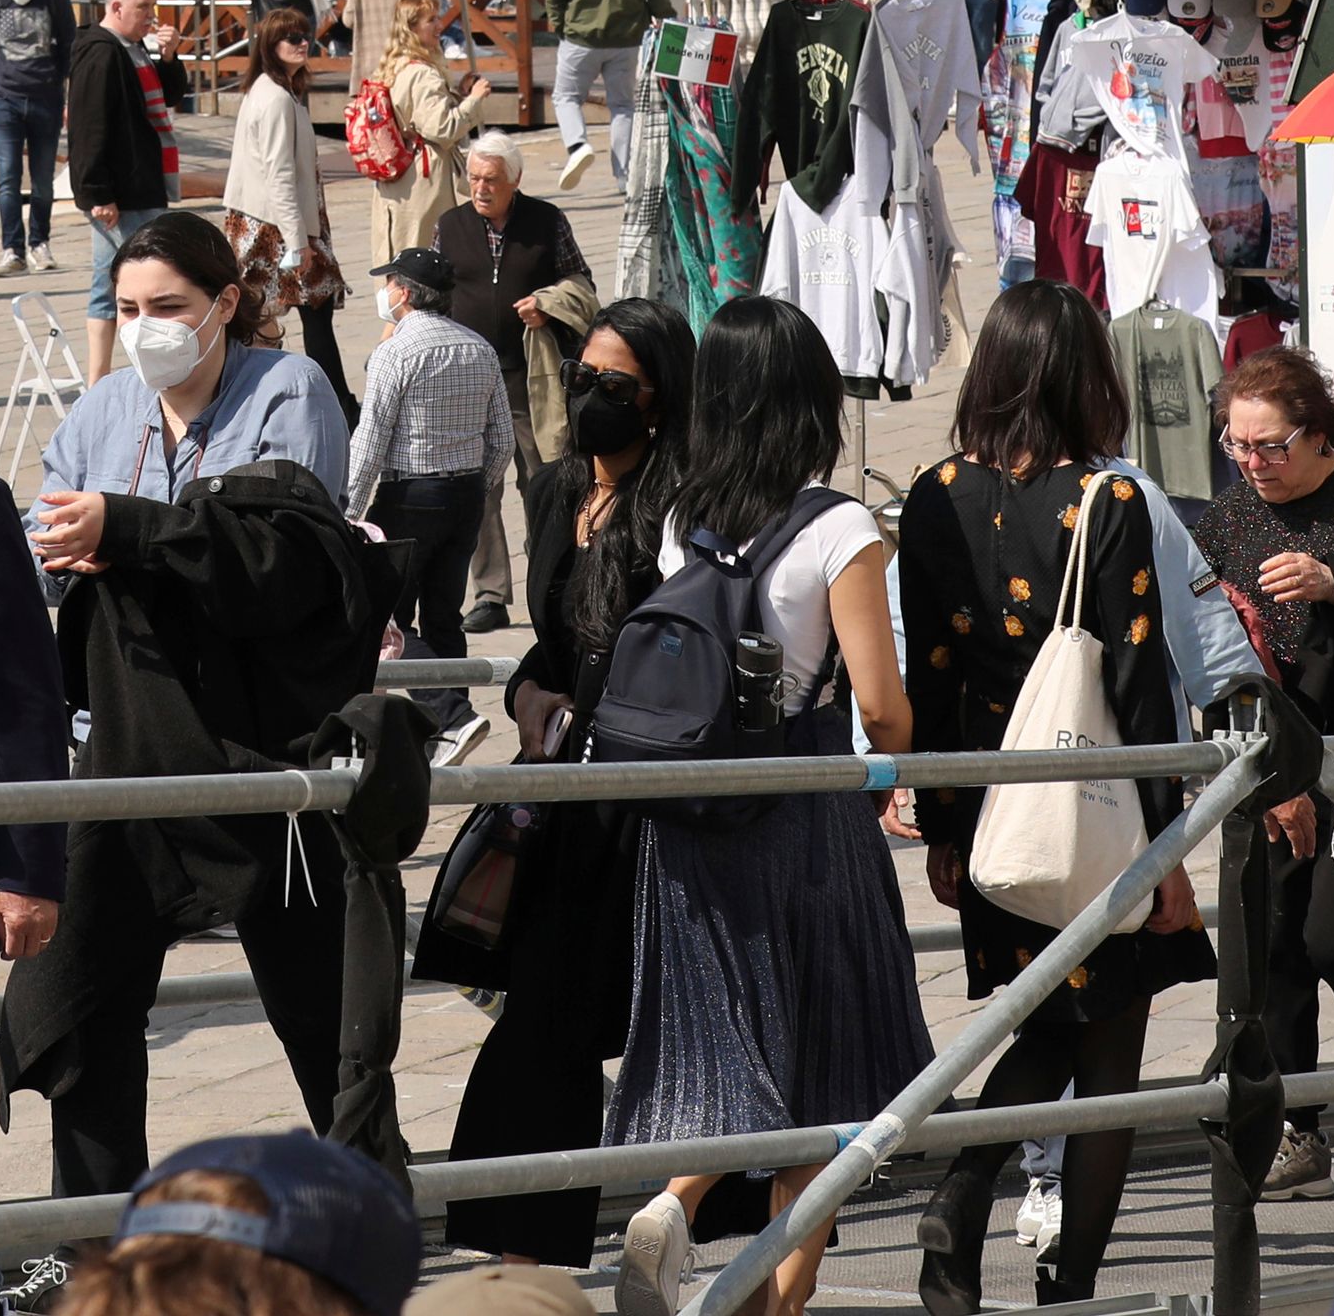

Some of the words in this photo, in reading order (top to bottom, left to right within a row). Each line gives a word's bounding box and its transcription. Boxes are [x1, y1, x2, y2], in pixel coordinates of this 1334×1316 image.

[667, 45, 692, 57] Made
[695, 51, 704, 60] in
[706, 52, 728, 65] Italy
[1110, 40, 1168, 67] Venezia
[797, 42, 849, 90] ENEZIA
[1056, 730, 1101, 748] ROT
[1098, 793, 1119, 808] YORK
